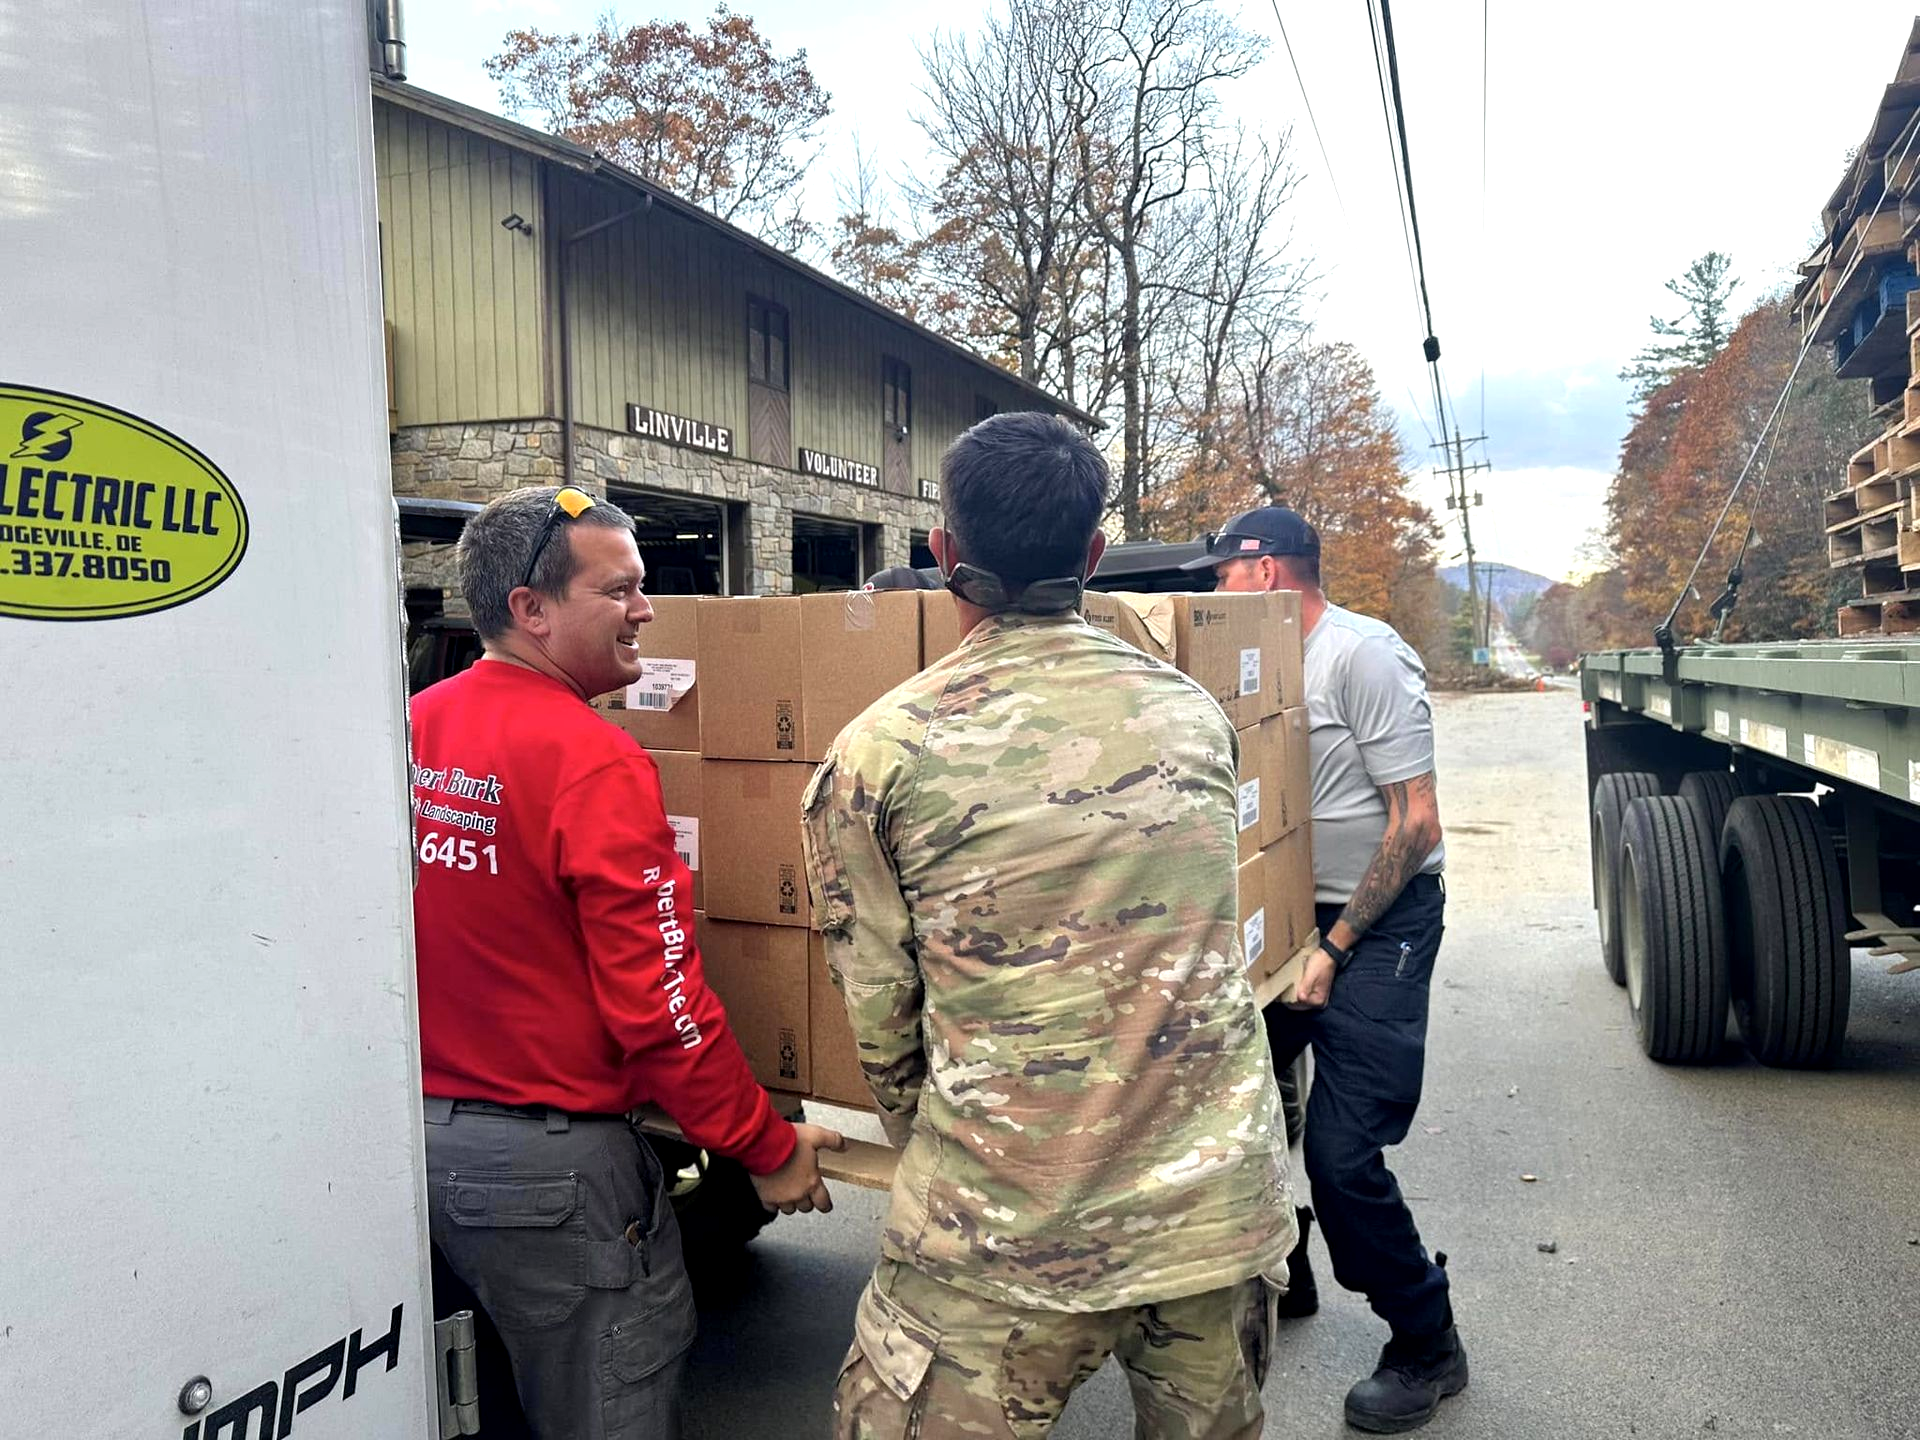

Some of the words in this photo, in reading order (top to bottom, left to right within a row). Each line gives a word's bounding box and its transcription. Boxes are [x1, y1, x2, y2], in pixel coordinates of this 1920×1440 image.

[634, 406, 729, 452] LINVILLE
[804, 450, 878, 486] VOLUNTEER
[162, 485, 222, 536] LLC
[117, 534, 142, 552] DE
[446, 768, 503, 805] Burk
[420, 800, 496, 836] Landscaping
[419, 832, 498, 875] 6451
